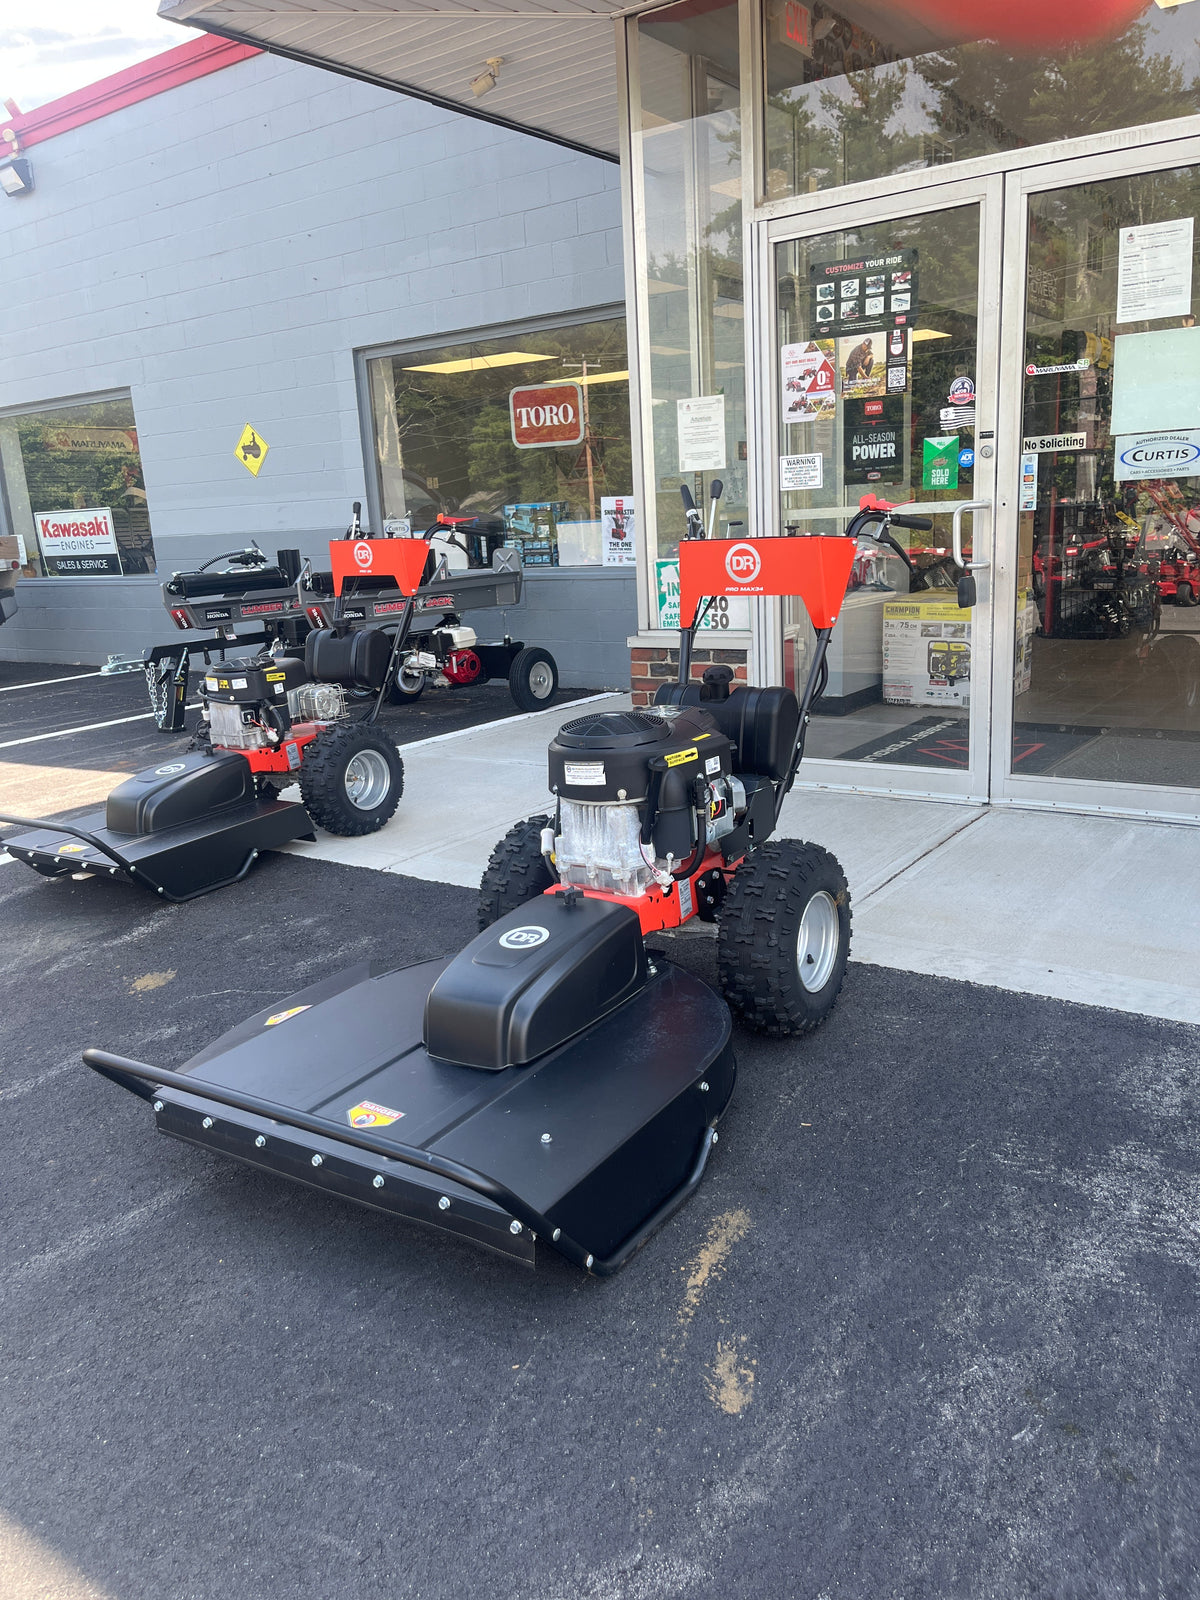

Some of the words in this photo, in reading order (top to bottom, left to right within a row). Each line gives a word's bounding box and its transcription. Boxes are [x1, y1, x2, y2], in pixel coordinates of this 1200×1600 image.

[785, 1, 808, 47] EXIT
[825, 262, 864, 275] CUSTOMIZE
[865, 259, 885, 268] YOUR
[885, 255, 903, 265] RIDE
[1035, 365, 1076, 374] MARUYAMA
[517, 403, 573, 429] TORO
[852, 432, 896, 445] ALL-SEASON
[1024, 440, 1037, 450] No
[1039, 436, 1085, 449] Soliciting
[1136, 436, 1169, 446] AUTHORIZED
[71, 440, 126, 450] MARUYAMA
[852, 442, 896, 461] POWER
[1132, 449, 1190, 462] CURTIS
[786, 458, 816, 466] WARNING
[931, 468, 950, 477] SOLD
[931, 476, 949, 485] HERE
[40, 516, 110, 538] Kawasaki
[60, 539, 95, 551] ENGINES
[358, 550, 370, 560] DR
[56, 560, 76, 570] SALES
[81, 559, 109, 569] SERVICE
[731, 556, 754, 571] DR
[666, 582, 680, 596] IN
[426, 597, 452, 607] JACK
[241, 603, 283, 615] LUMBER
[885, 606, 920, 614] CHAMPION
[703, 613, 730, 630] $50
[508, 931, 541, 943] DR
[362, 1103, 398, 1119] DANGER
